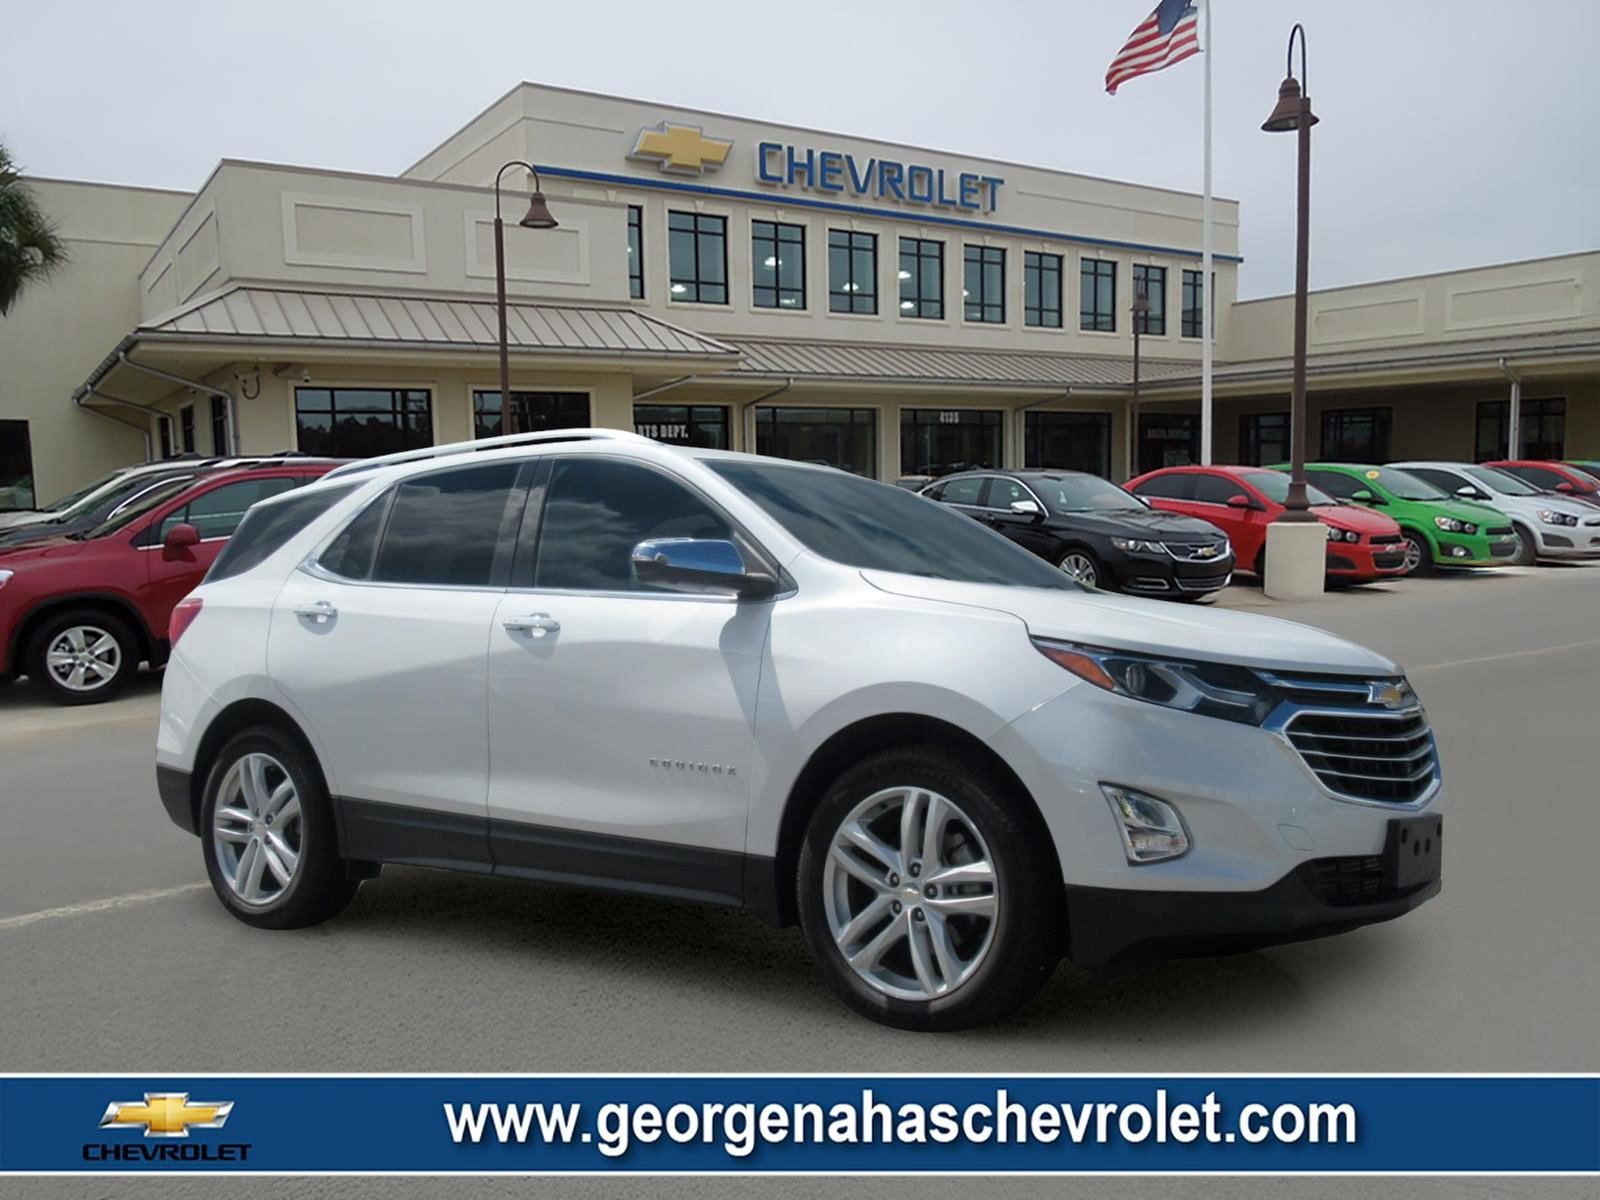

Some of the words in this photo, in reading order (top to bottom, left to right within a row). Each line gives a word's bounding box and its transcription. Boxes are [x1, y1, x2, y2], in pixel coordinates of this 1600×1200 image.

[757, 141, 1004, 212] CHEVROLET
[660, 424, 689, 438] DEPT.
[648, 757, 737, 776] EQUINOX
